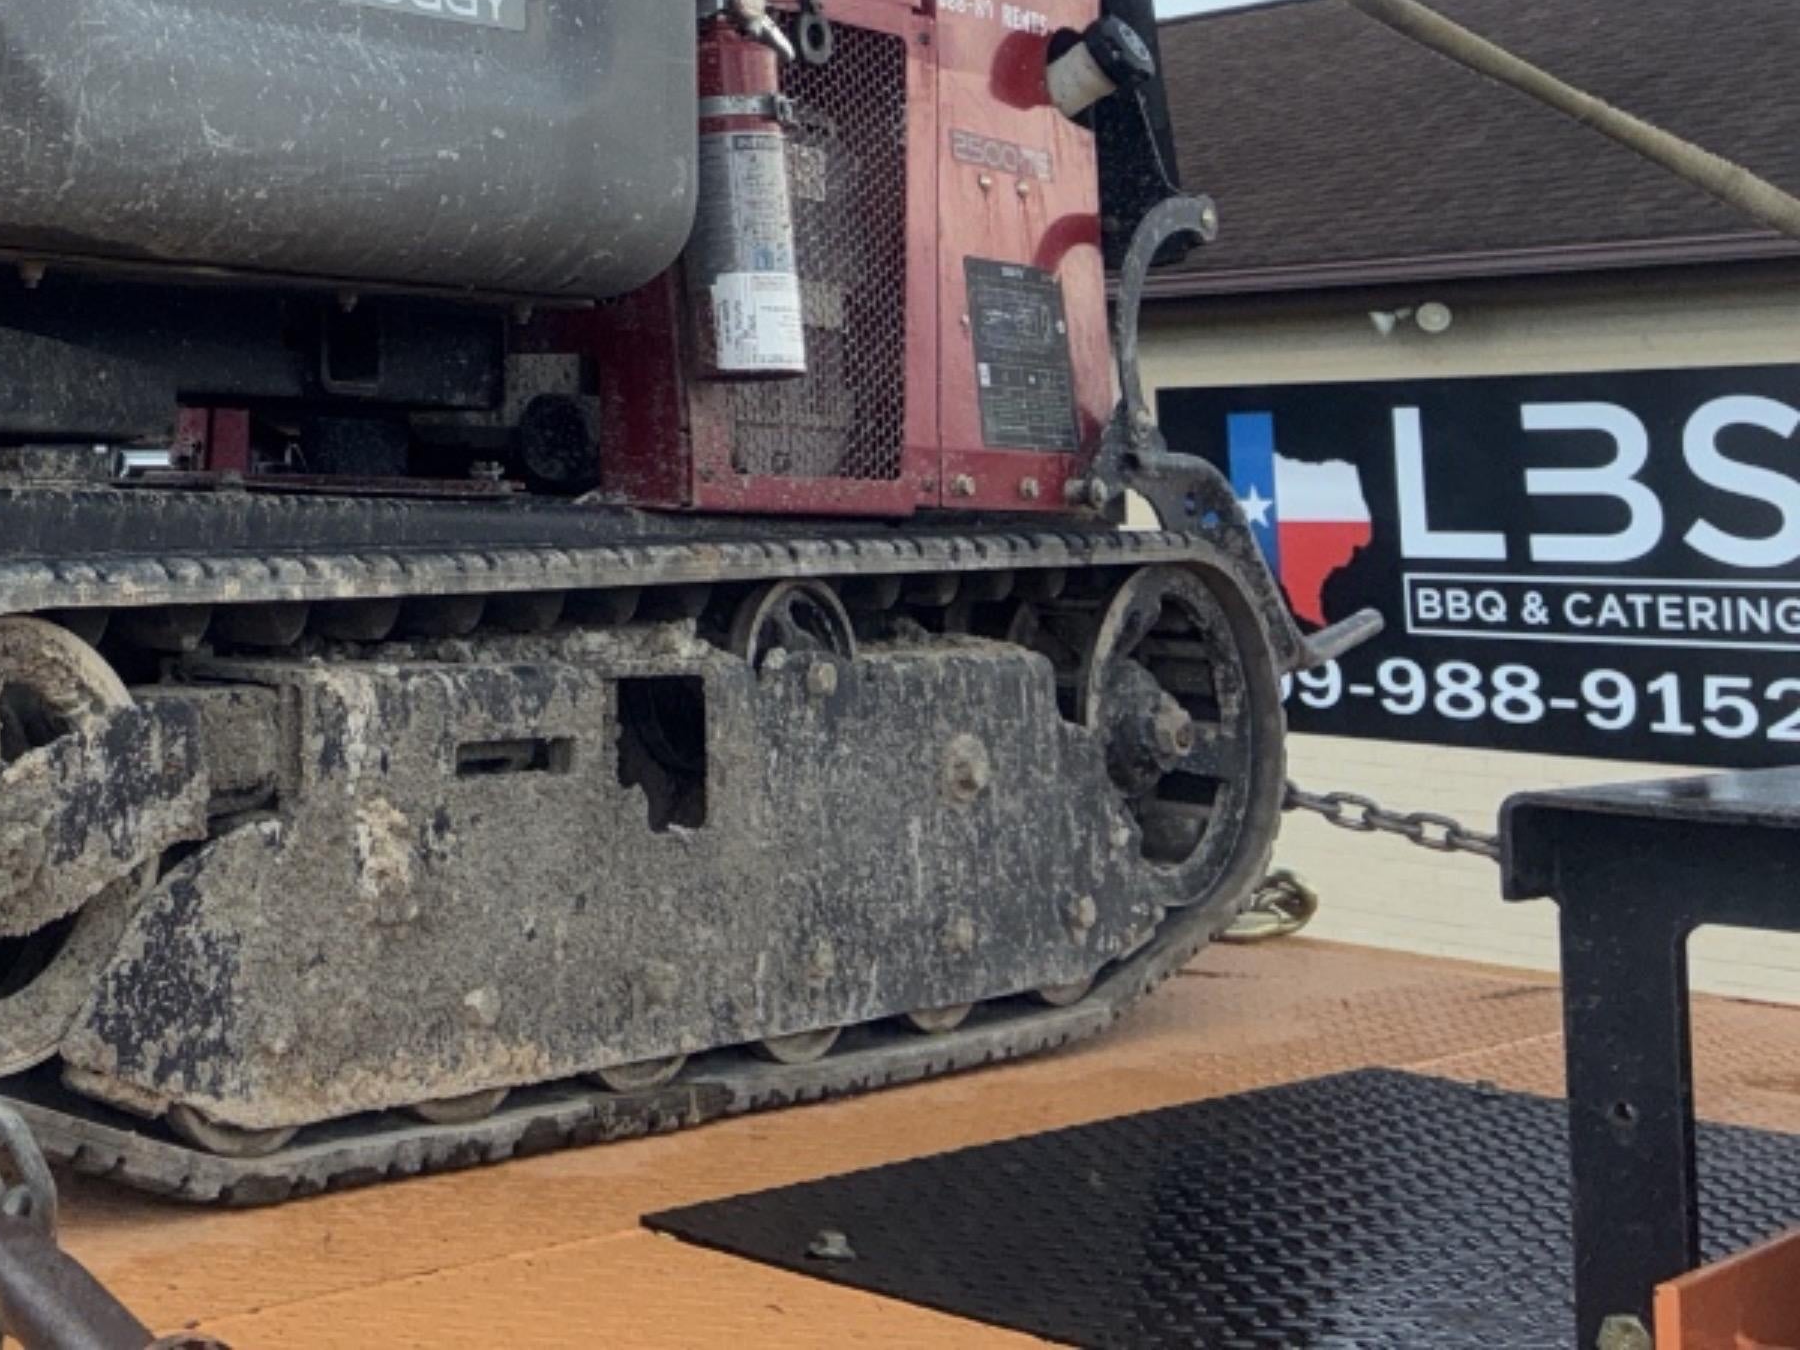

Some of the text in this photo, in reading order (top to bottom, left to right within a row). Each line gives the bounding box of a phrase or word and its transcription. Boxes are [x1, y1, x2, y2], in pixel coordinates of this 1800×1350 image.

[1416, 587, 1800, 635] BBQ & CATERING
